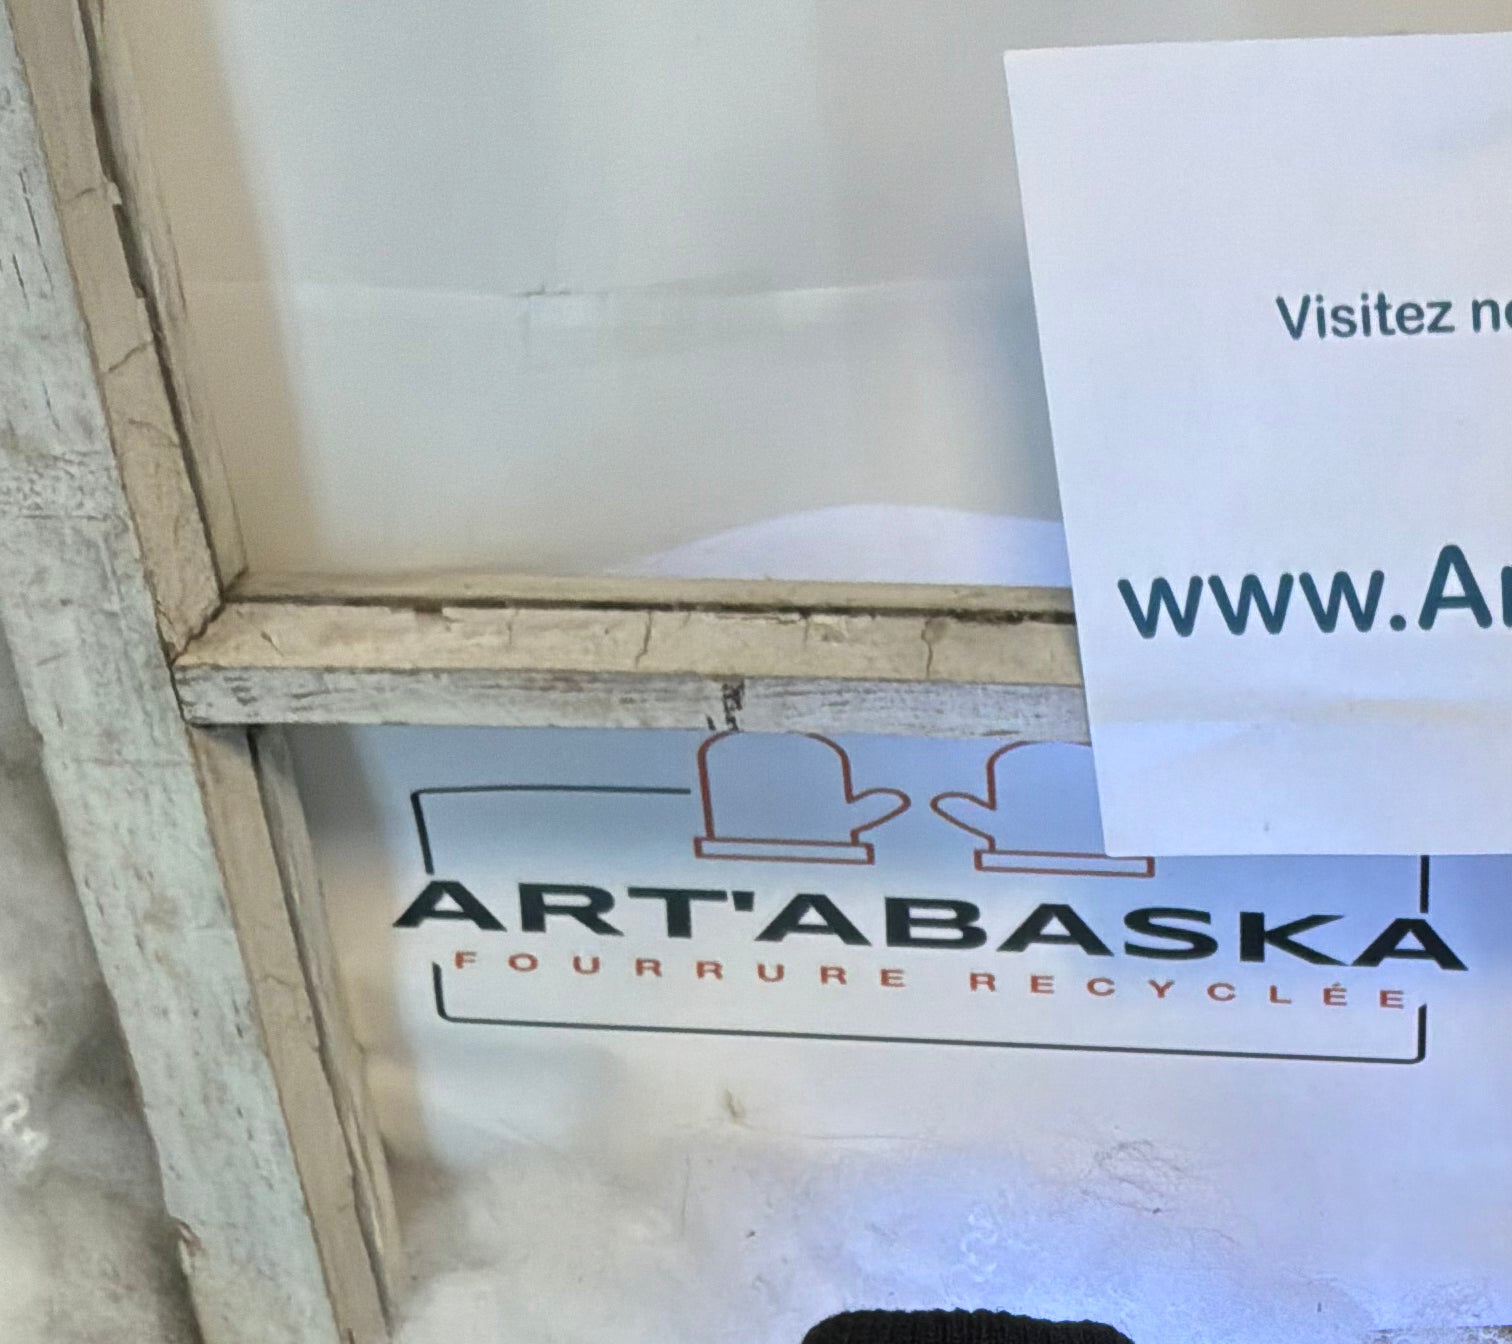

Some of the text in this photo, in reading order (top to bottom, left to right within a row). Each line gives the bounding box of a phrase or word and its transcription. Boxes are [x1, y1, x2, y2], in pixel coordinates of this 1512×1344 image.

[1275, 291, 1456, 341] Visitez
[391, 879, 1467, 972] ART'ABASKA
[453, 951, 1407, 1010] FOURRURE RECYCLÉE
